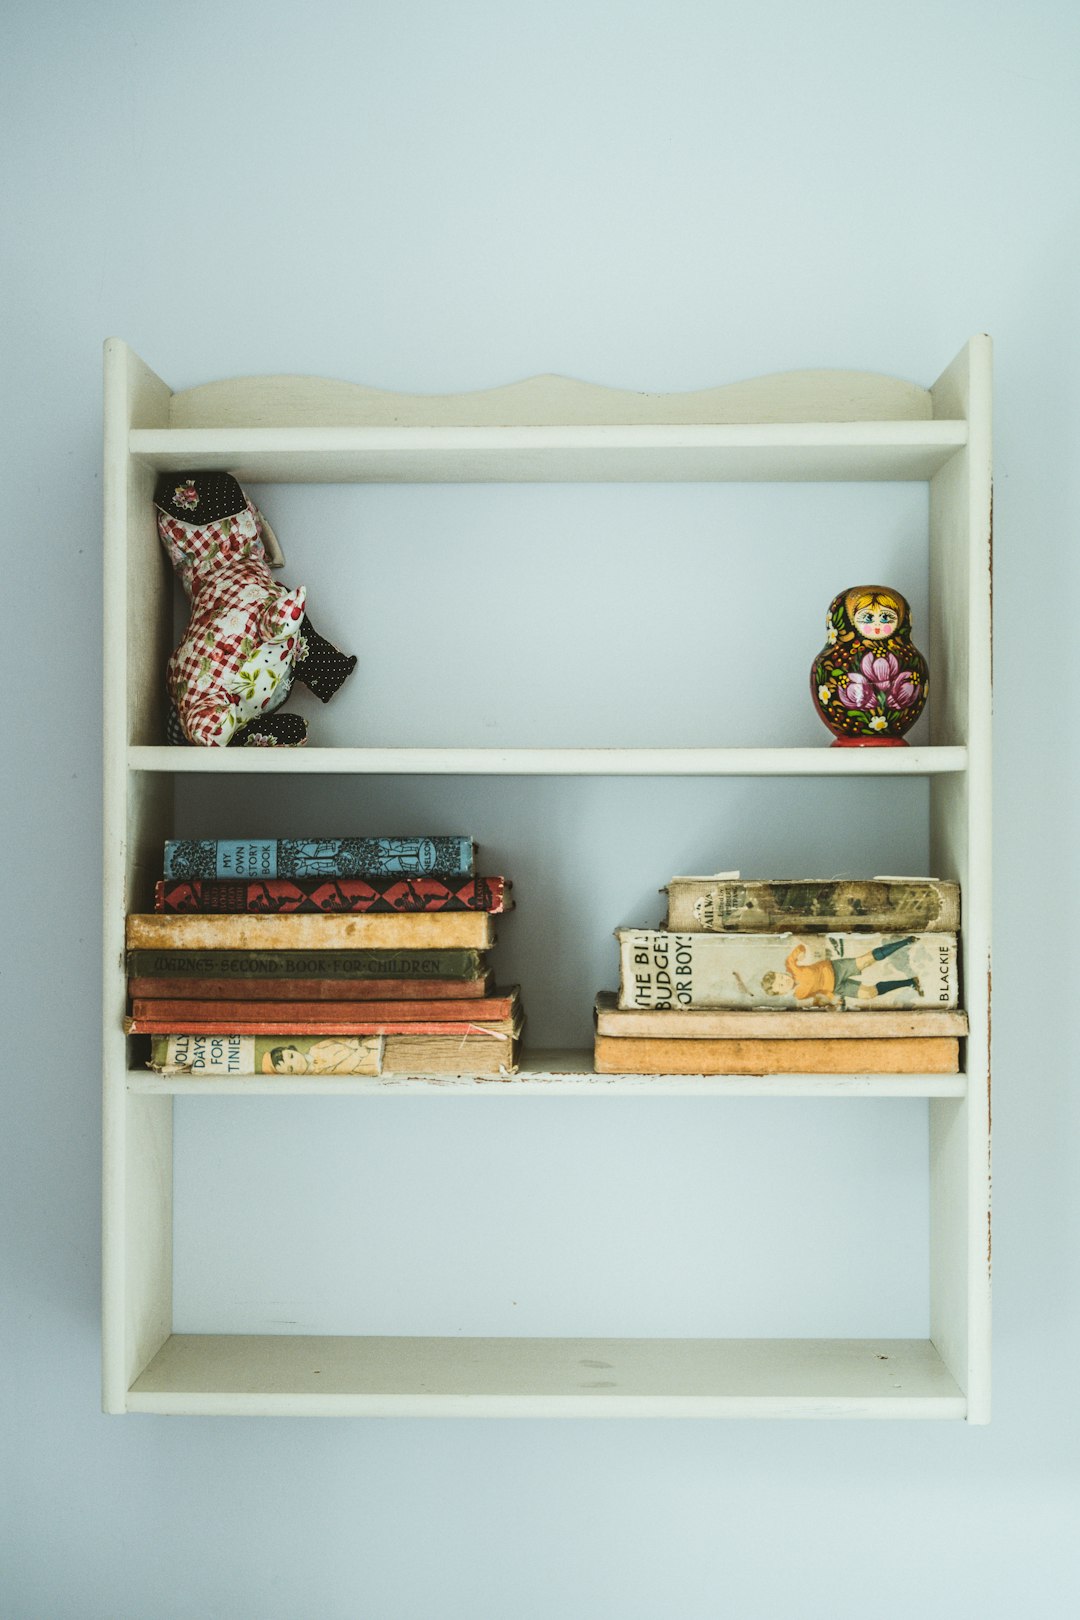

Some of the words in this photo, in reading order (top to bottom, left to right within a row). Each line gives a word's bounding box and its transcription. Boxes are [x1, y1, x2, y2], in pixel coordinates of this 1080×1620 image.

[223, 853, 232, 868] MY
[236, 846, 245, 874] OWN
[249, 844, 257, 877] STORY
[262, 845, 270, 875] BOOK
[424, 839, 432, 872] NELSON
[220, 959, 278, 973] SECOND
[285, 959, 326, 973] BOOK
[333, 959, 362, 973] FOR
[367, 959, 440, 973] CHILDREN
[939, 946, 949, 1001] BLACKIE
[634, 973, 652, 1007] THE
[676, 980, 693, 1005] OR
[194, 1036, 206, 1069] DAYS
[211, 1039, 224, 1064] FOR
[228, 1034, 241, 1073] TINIES
